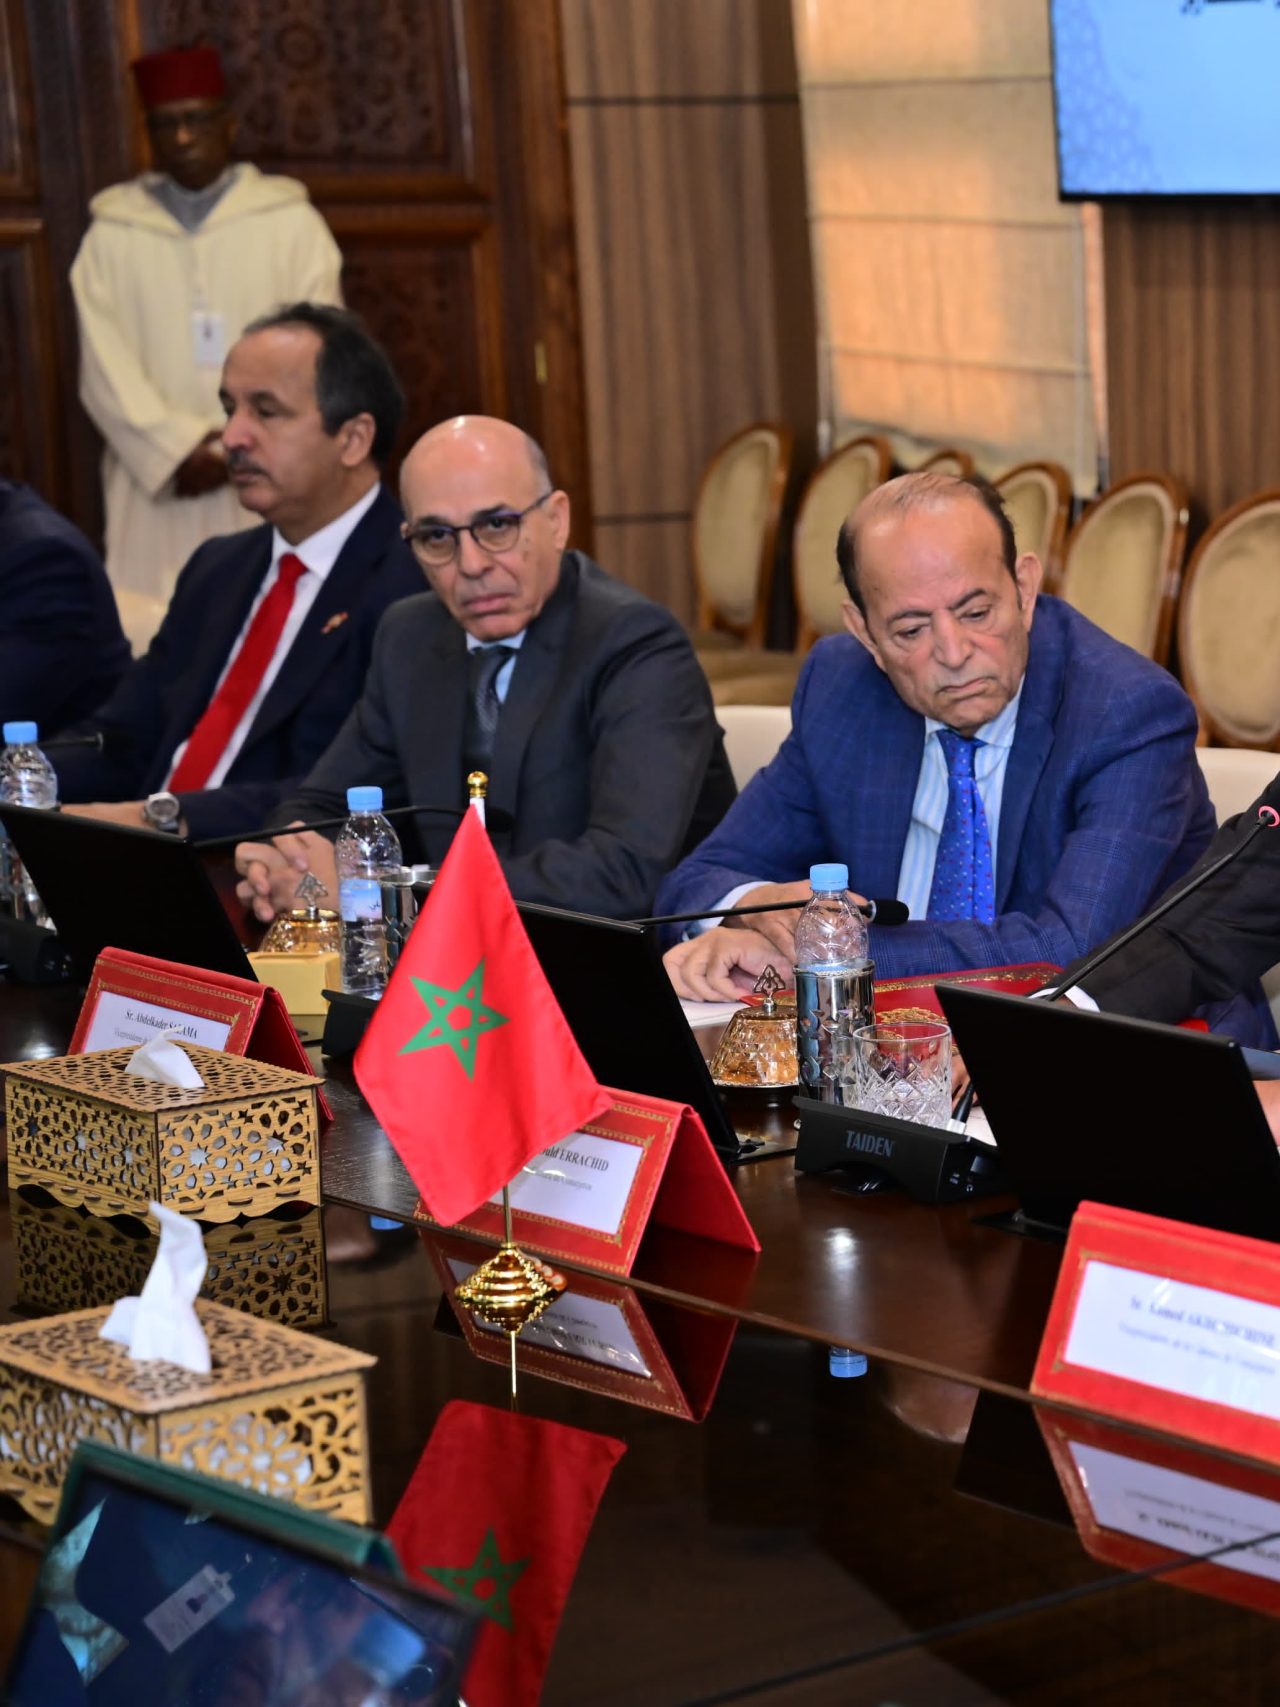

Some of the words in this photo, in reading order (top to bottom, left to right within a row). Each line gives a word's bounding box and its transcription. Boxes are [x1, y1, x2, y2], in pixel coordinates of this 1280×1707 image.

[168, 1020, 197, 1039] SAMA
[845, 1129, 895, 1158] TAIDEN
[559, 1149, 609, 1171] ERRACHID
